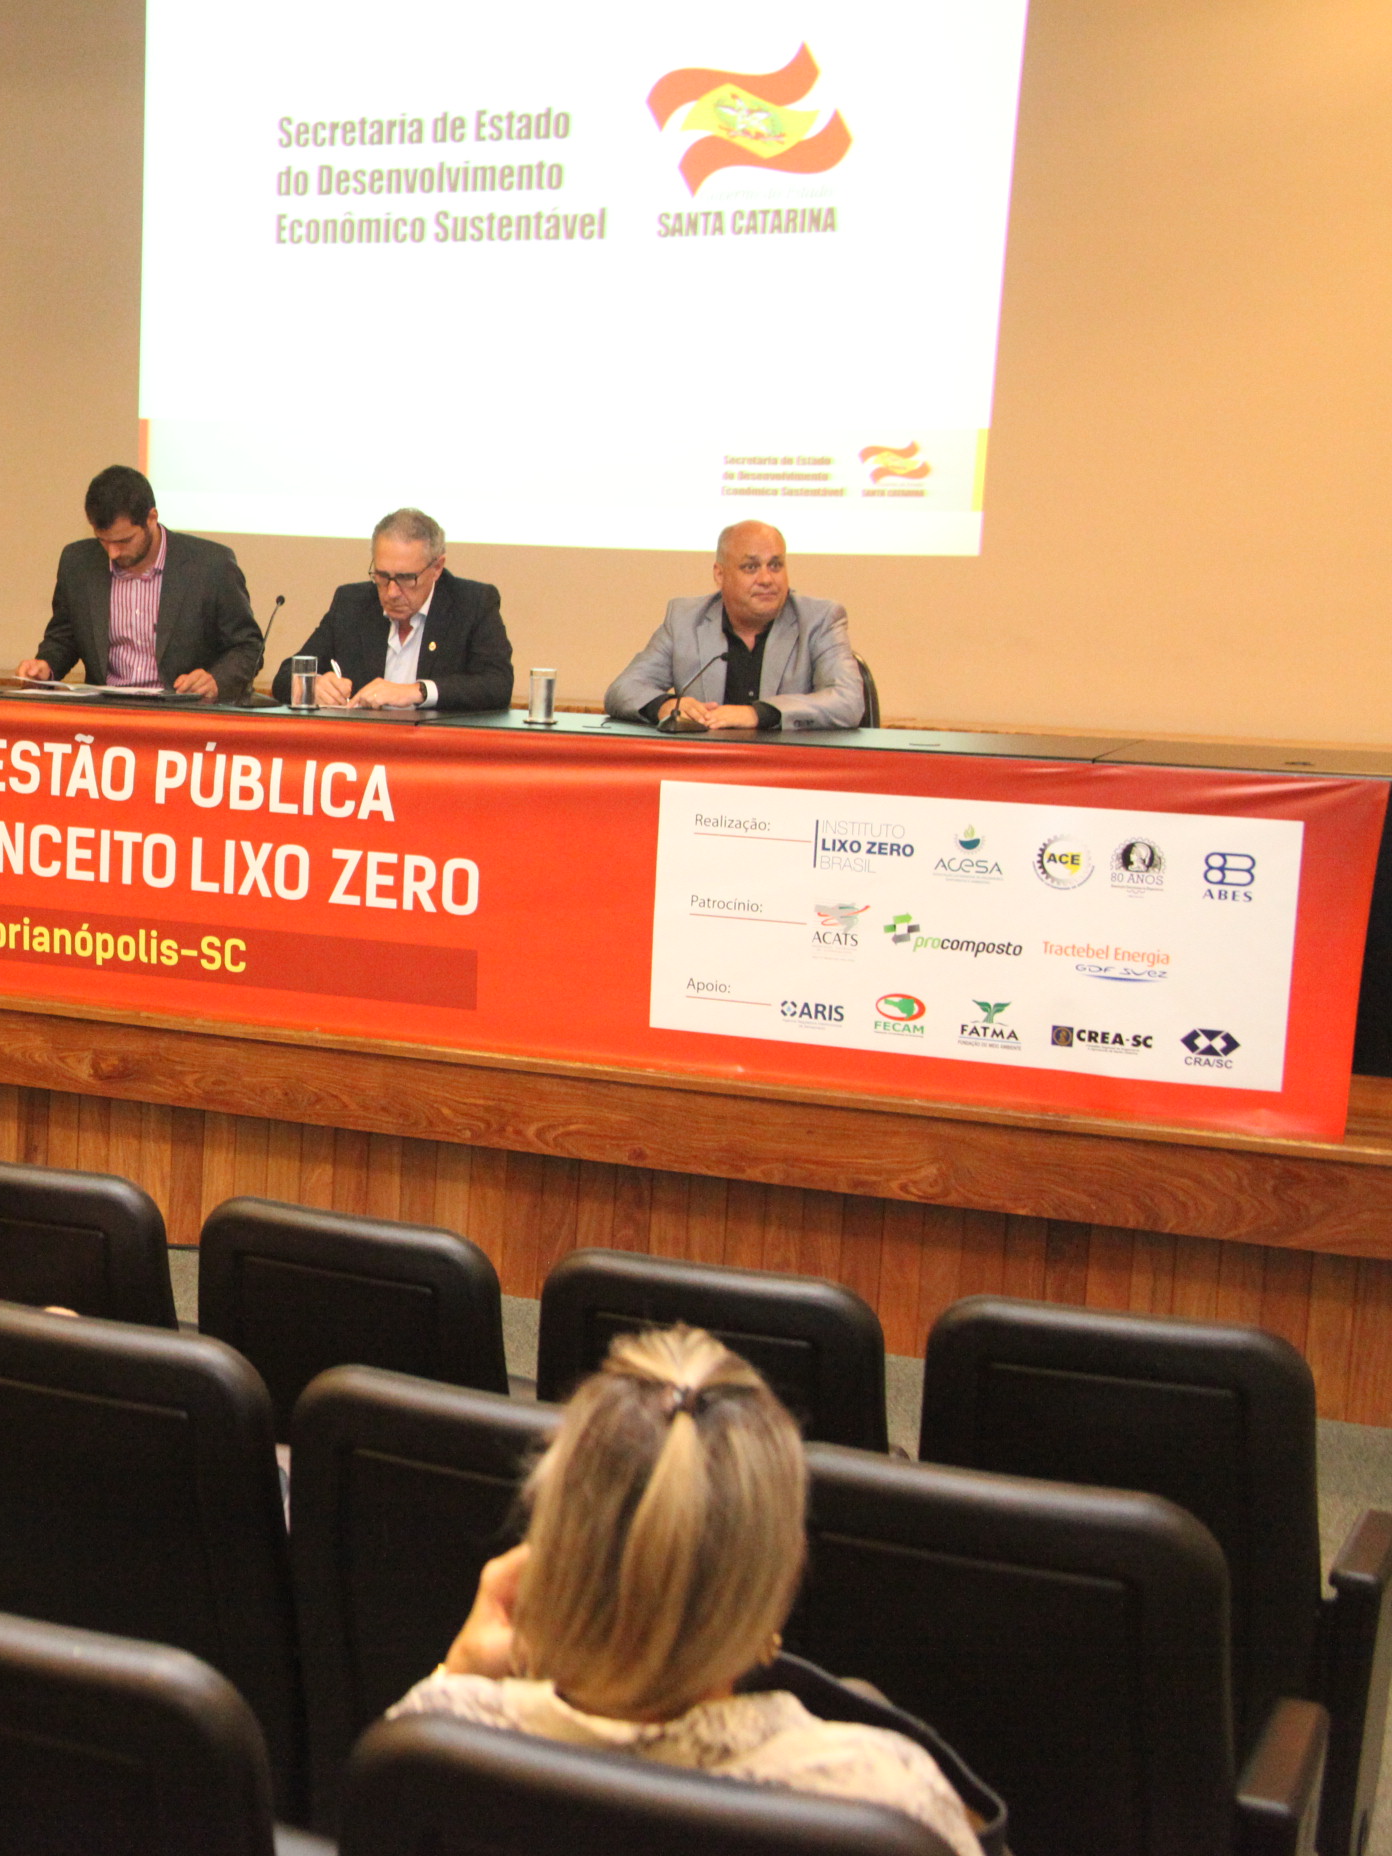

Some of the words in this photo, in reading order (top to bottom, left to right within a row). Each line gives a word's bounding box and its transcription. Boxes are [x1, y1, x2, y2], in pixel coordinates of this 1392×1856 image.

[277, 112, 425, 149] Secretaria
[431, 111, 467, 144] de
[474, 106, 572, 143] Estado
[276, 165, 310, 197] do
[317, 160, 565, 197] Desenvolvimento
[275, 211, 428, 245] Econômico
[433, 206, 608, 243] Sustentável
[656, 210, 726, 238] SANTA
[730, 206, 838, 236] CATARINA
[155, 741, 395, 822] PÚBLICA
[694, 813, 771, 832] Realização:
[821, 819, 906, 839] INSTITUTO
[821, 838, 862, 854] LIXO
[866, 841, 915, 858] ZERO
[819, 855, 877, 873] BRASIL
[1046, 853, 1081, 866] ACE
[191, 837, 310, 901] LIXO
[328, 848, 480, 916] ZERO
[1110, 872, 1124, 883] 80
[1127, 872, 1164, 886] ANOS
[690, 894, 763, 913] Patrocínio:
[1203, 888, 1253, 902] ABES
[811, 931, 859, 946] ACATS
[913, 935, 1023, 958] procomposto
[1042, 940, 1109, 960] Tractebel
[1114, 947, 1170, 968] Energia
[1075, 963, 1114, 974] GDF
[686, 978, 731, 993] Apoio:
[798, 1002, 845, 1022] ARIS
[874, 1020, 925, 1035] FECAM
[960, 1024, 1019, 1041] FATMA
[1076, 1029, 1154, 1048] CREA-SC
[1184, 1055, 1234, 1069] CRA/SC
